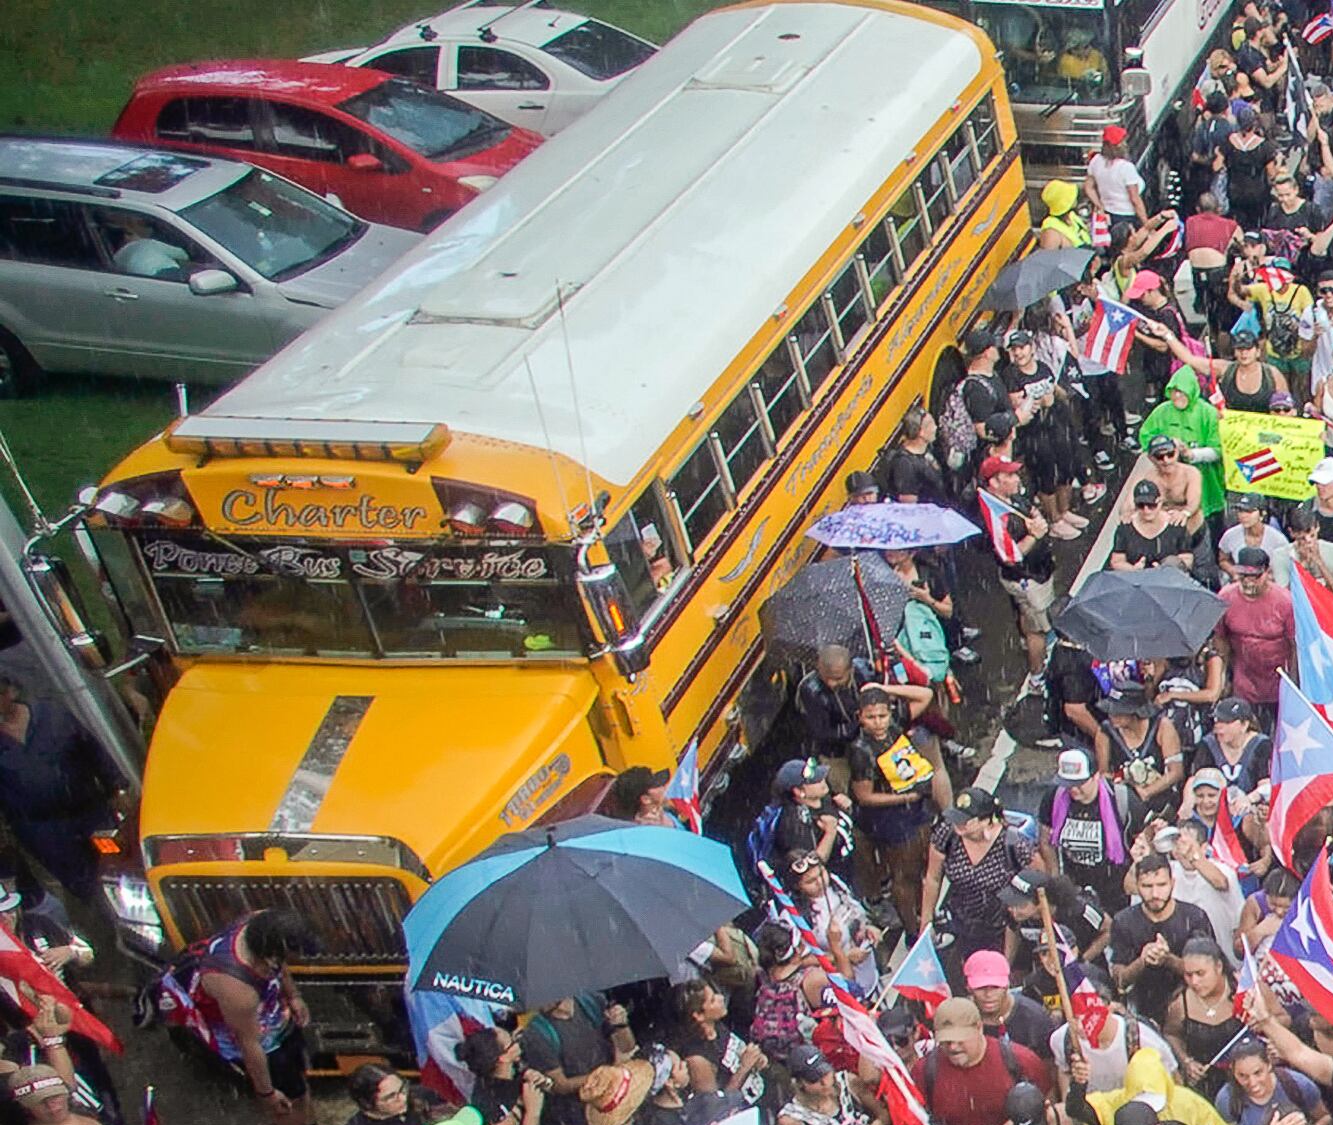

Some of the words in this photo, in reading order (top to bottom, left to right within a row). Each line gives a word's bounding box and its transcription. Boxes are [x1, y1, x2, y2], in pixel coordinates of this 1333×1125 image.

[222, 489, 428, 529] Charter
[351, 547, 548, 579] Service
[433, 971, 516, 1002] NAUTICA
